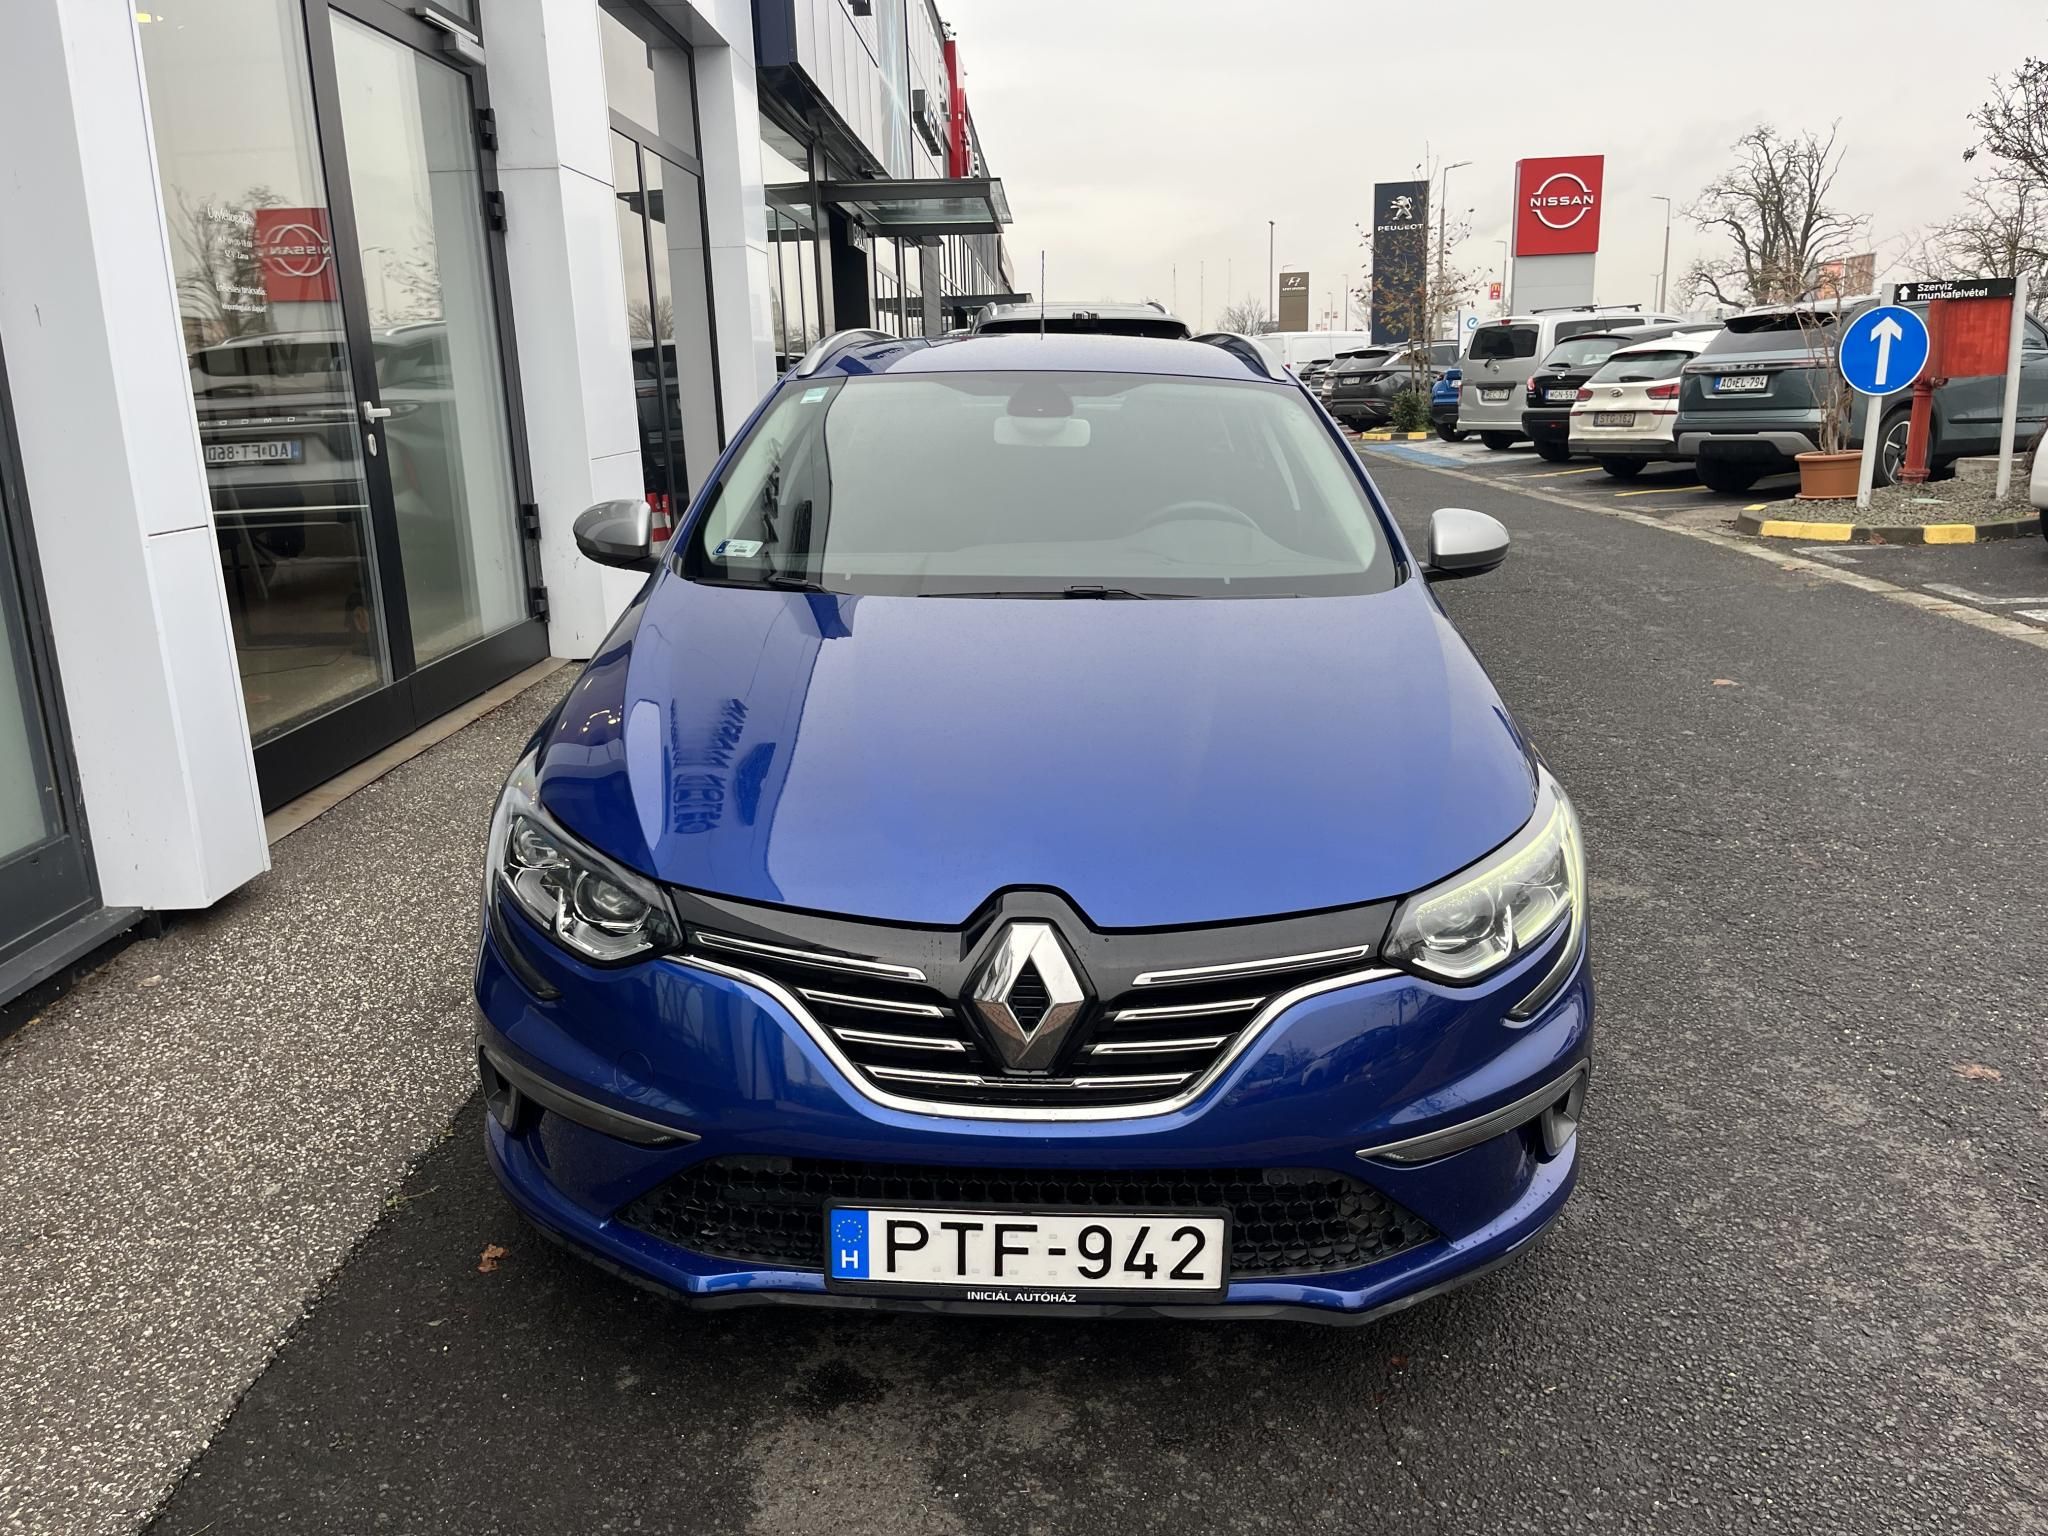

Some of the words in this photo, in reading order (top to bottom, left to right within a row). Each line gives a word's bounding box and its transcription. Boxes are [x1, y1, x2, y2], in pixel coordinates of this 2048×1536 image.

[1530, 195, 1594, 207] NISSAN
[1378, 223, 1424, 231] PEUGEOT
[1917, 282, 1953, 292] Szerviz
[1917, 287, 1988, 300] munkafelvétel
[886, 1219, 1207, 1281] PTF-942
[841, 1249, 859, 1269] H
[967, 1290, 1012, 1302] INICIÁL
[1015, 1292, 1077, 1303] AUTÓHÁZ
